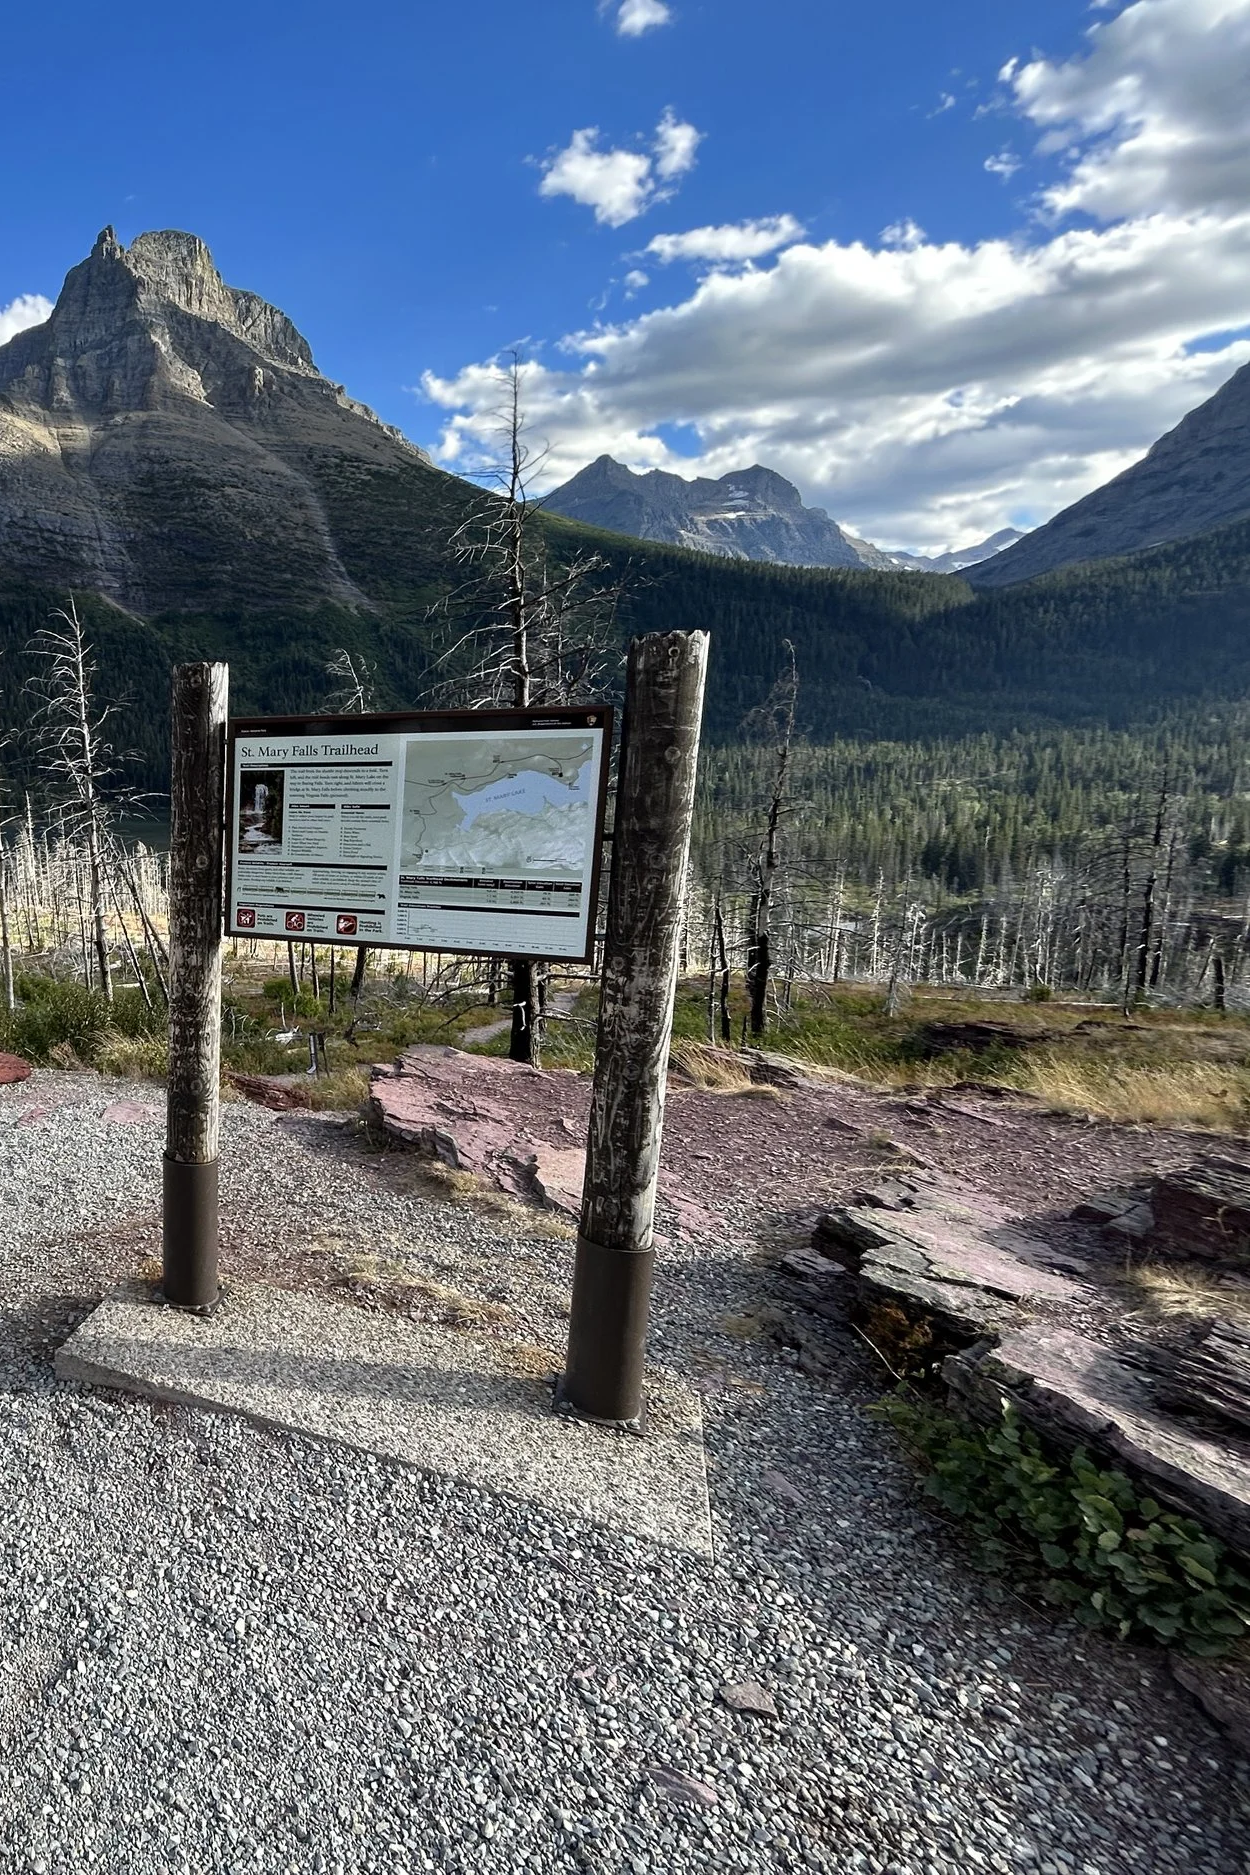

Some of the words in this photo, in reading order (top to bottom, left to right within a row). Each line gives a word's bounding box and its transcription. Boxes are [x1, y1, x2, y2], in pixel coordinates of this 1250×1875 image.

[241, 746, 255, 758] St.
[258, 746, 289, 760] Mary
[292, 745, 319, 757] Falls
[321, 744, 379, 756] Trailhead
